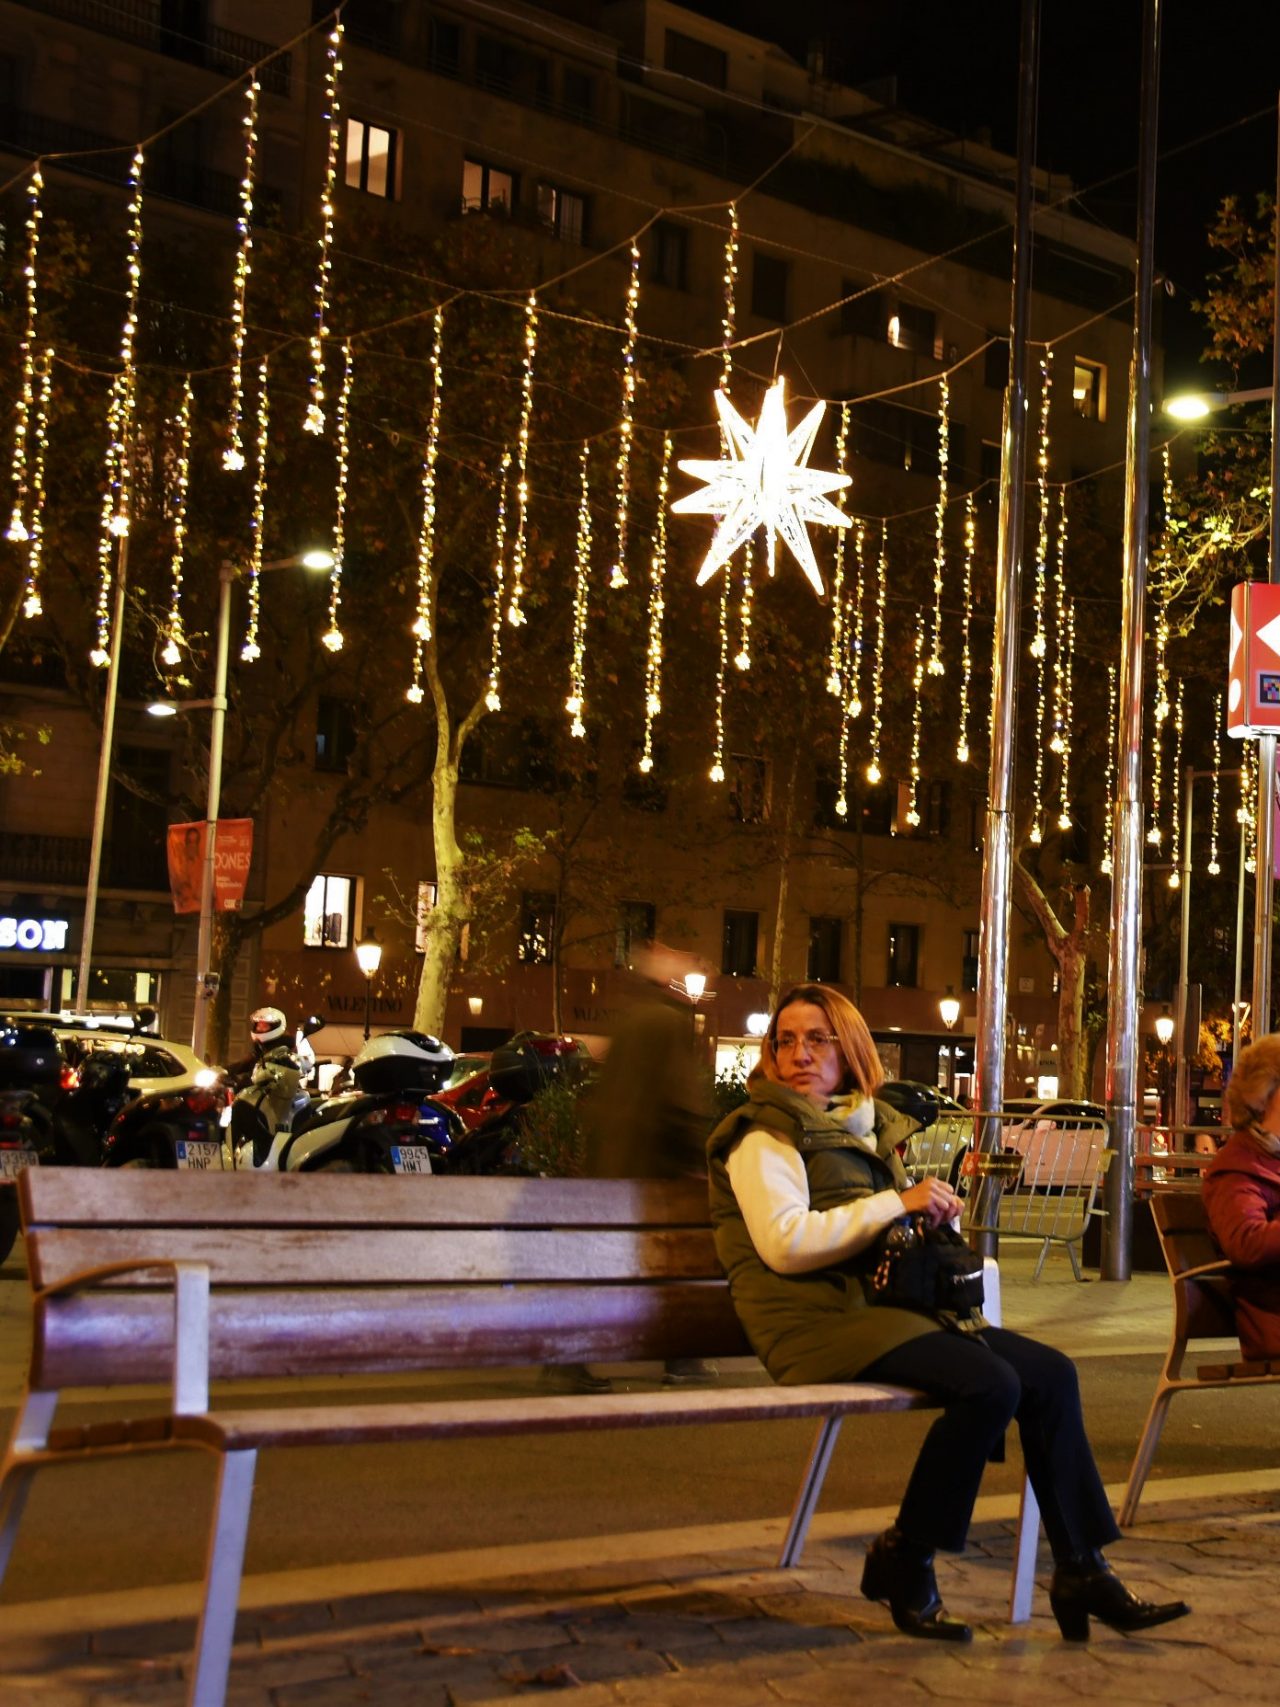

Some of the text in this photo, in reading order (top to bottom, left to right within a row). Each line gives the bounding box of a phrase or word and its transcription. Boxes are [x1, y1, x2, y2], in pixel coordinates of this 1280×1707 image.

[327, 996, 403, 1013] VALENTINO
[187, 1143, 218, 1156] 2157
[400, 1147, 428, 1160] 9945
[187, 1156, 211, 1169] HNP
